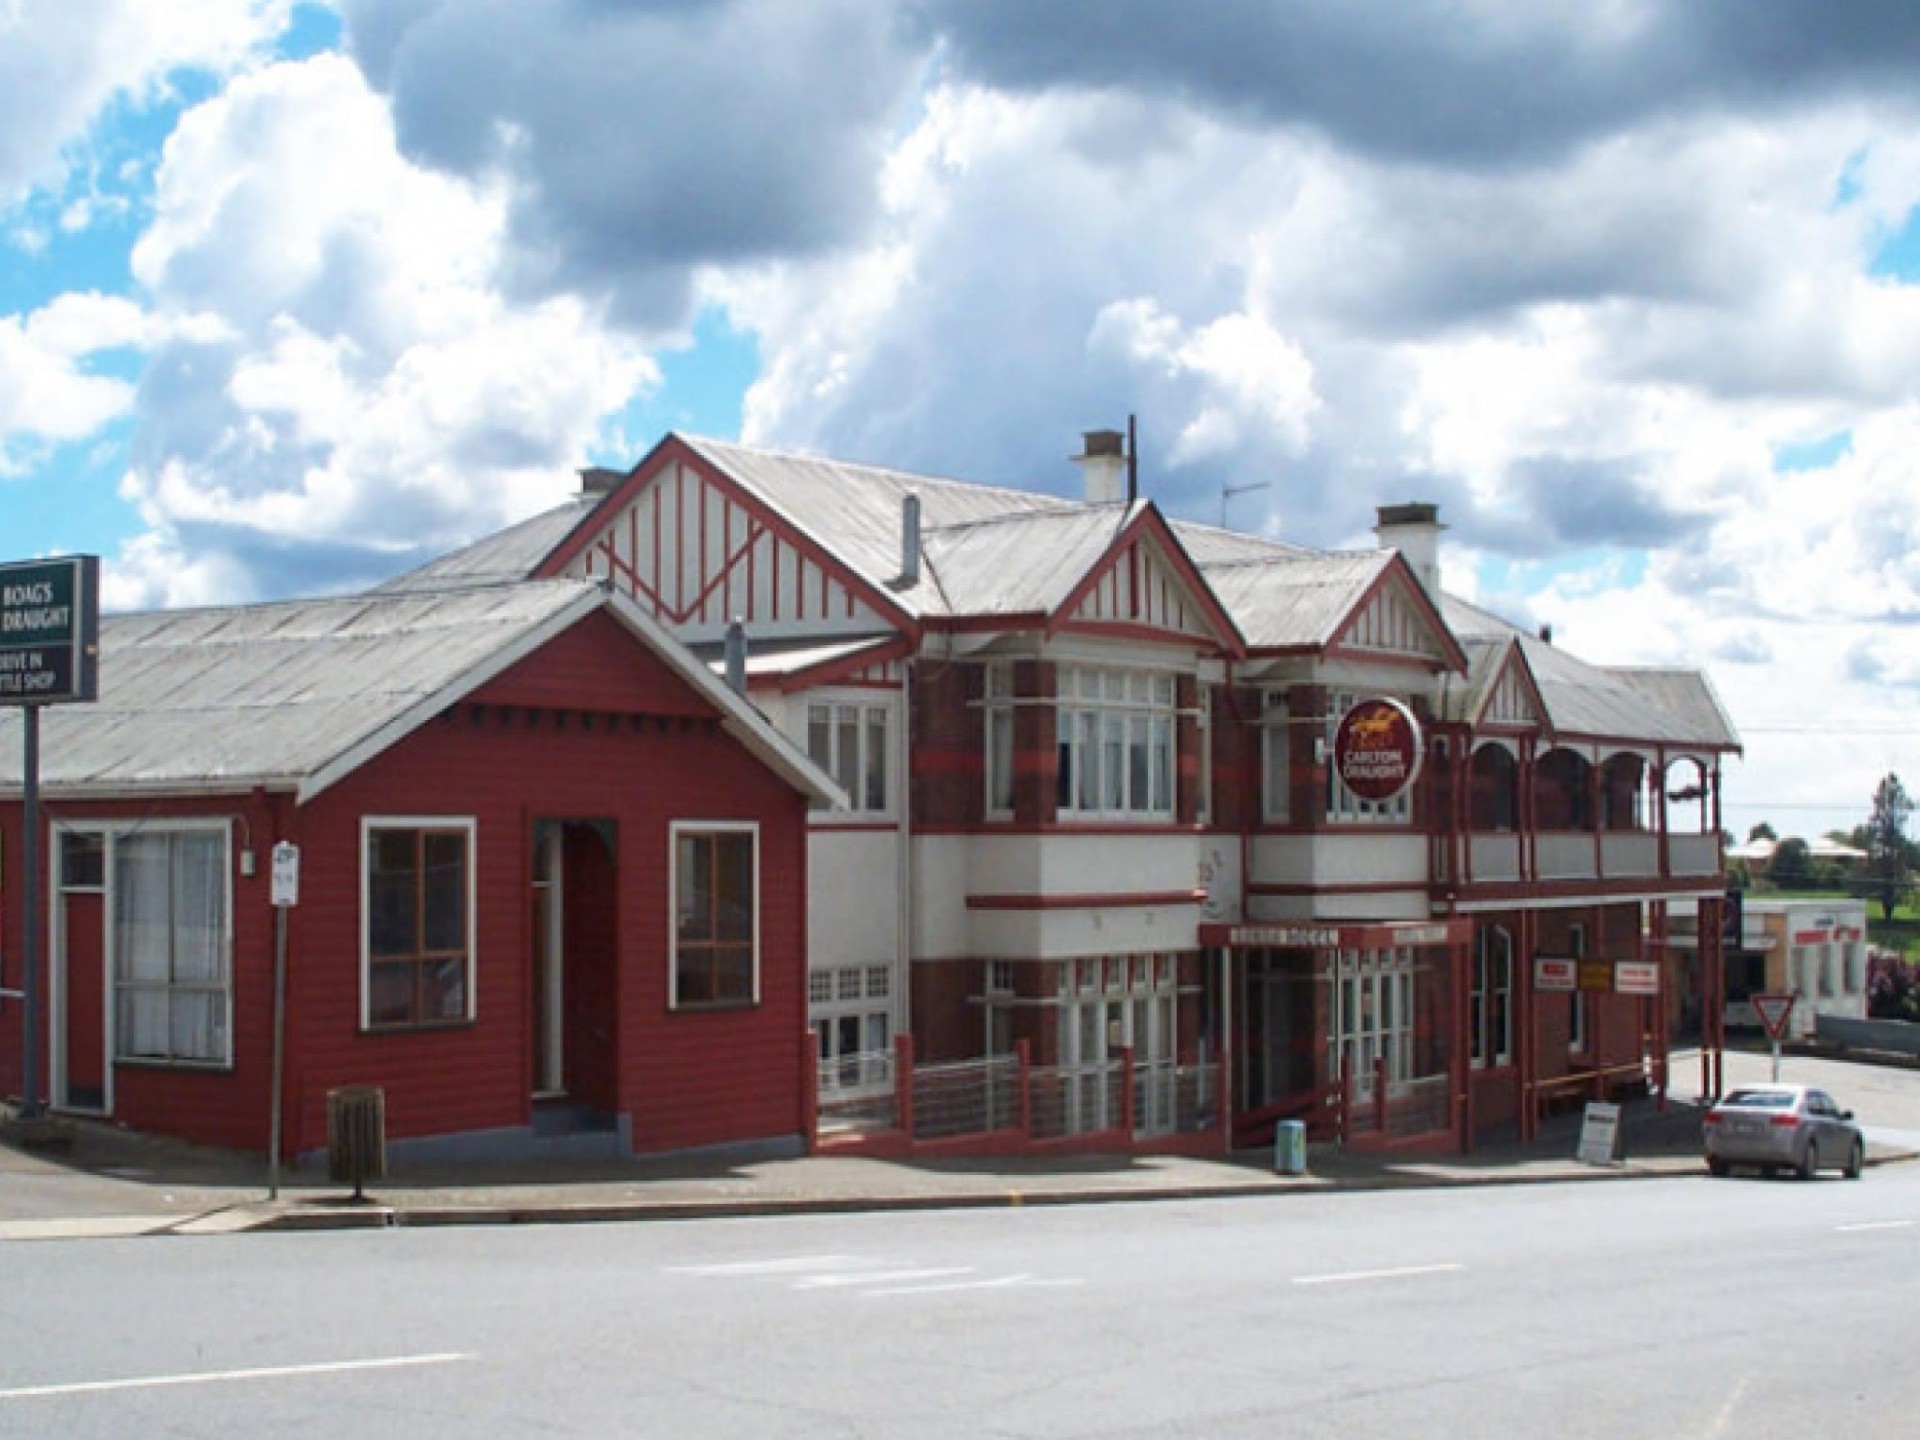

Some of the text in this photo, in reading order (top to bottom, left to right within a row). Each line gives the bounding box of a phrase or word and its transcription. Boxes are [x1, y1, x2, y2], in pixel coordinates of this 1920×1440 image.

[3, 605, 69, 632] DRAUGHT
[1343, 750, 1402, 765] CARLTON
[1343, 764, 1405, 779] DRAUGHT
